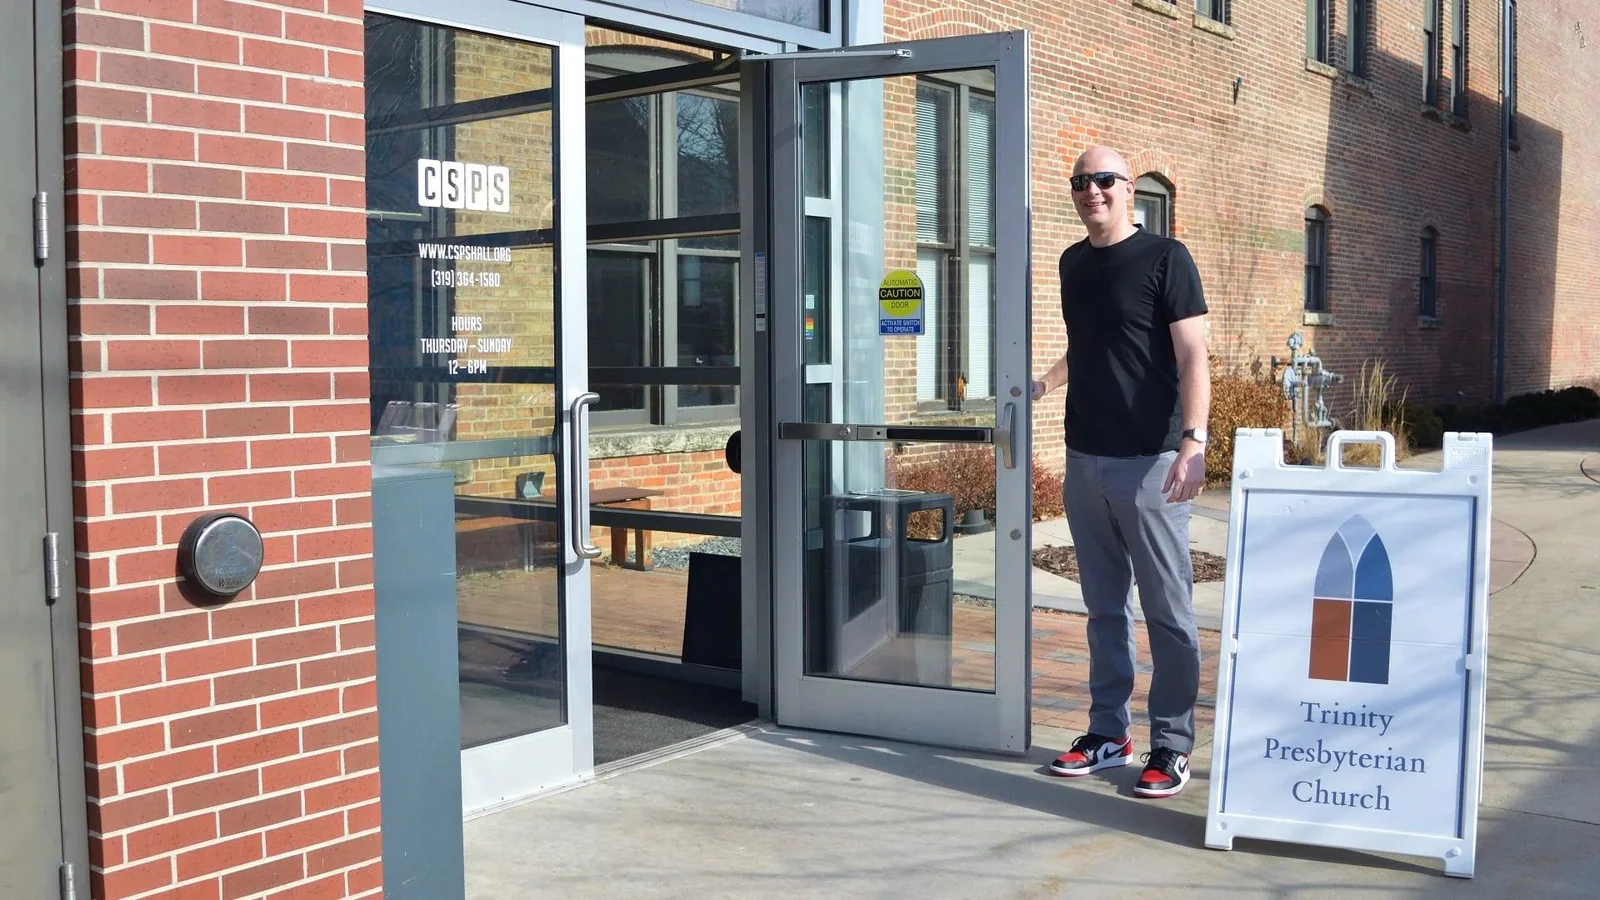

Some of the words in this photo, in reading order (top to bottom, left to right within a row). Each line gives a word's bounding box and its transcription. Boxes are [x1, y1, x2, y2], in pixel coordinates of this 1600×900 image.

[422, 164, 506, 208] CSPS
[418, 243, 511, 263] WWW.CSPSHALL.ORG
[431, 269, 455, 288] (319)
[457, 271, 500, 288] 364-1580
[883, 278, 918, 287] AUTOMATIC
[880, 288, 921, 298] CAUTION
[891, 301, 910, 309] DOOR
[451, 316, 483, 332] HOURS
[1300, 701, 1394, 736] Trinity
[1263, 737, 1427, 774] Presbyterian
[1291, 779, 1391, 811] Church
